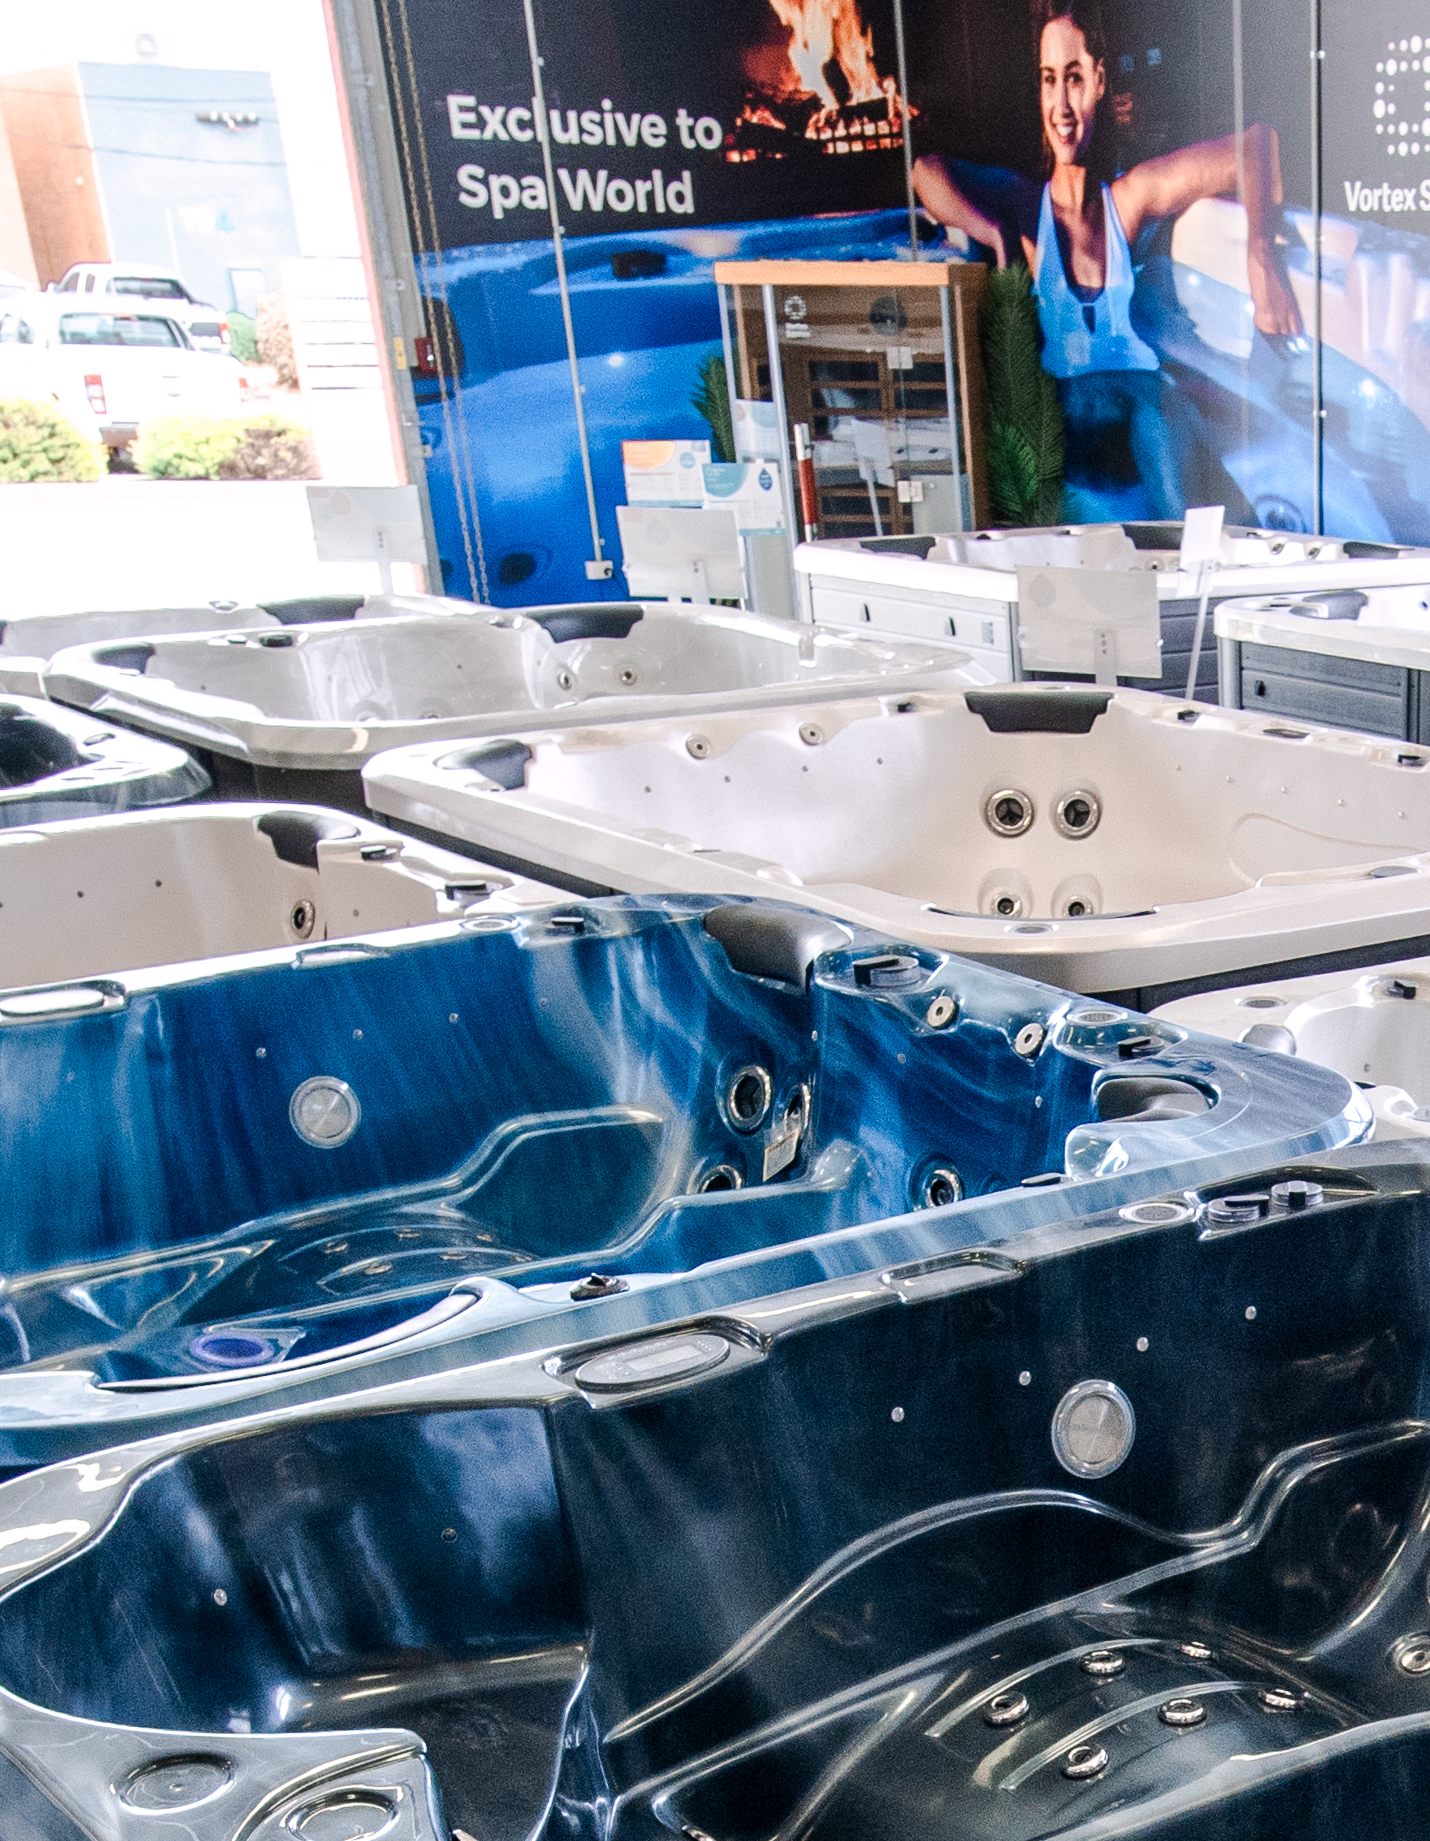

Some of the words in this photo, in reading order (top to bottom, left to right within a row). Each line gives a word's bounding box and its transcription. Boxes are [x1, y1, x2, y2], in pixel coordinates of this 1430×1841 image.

[446, 94, 668, 149] Exclusive
[675, 107, 723, 150] to
[456, 163, 548, 220] Spa
[557, 168, 695, 214] World
[1343, 180, 1417, 213] Vortex
